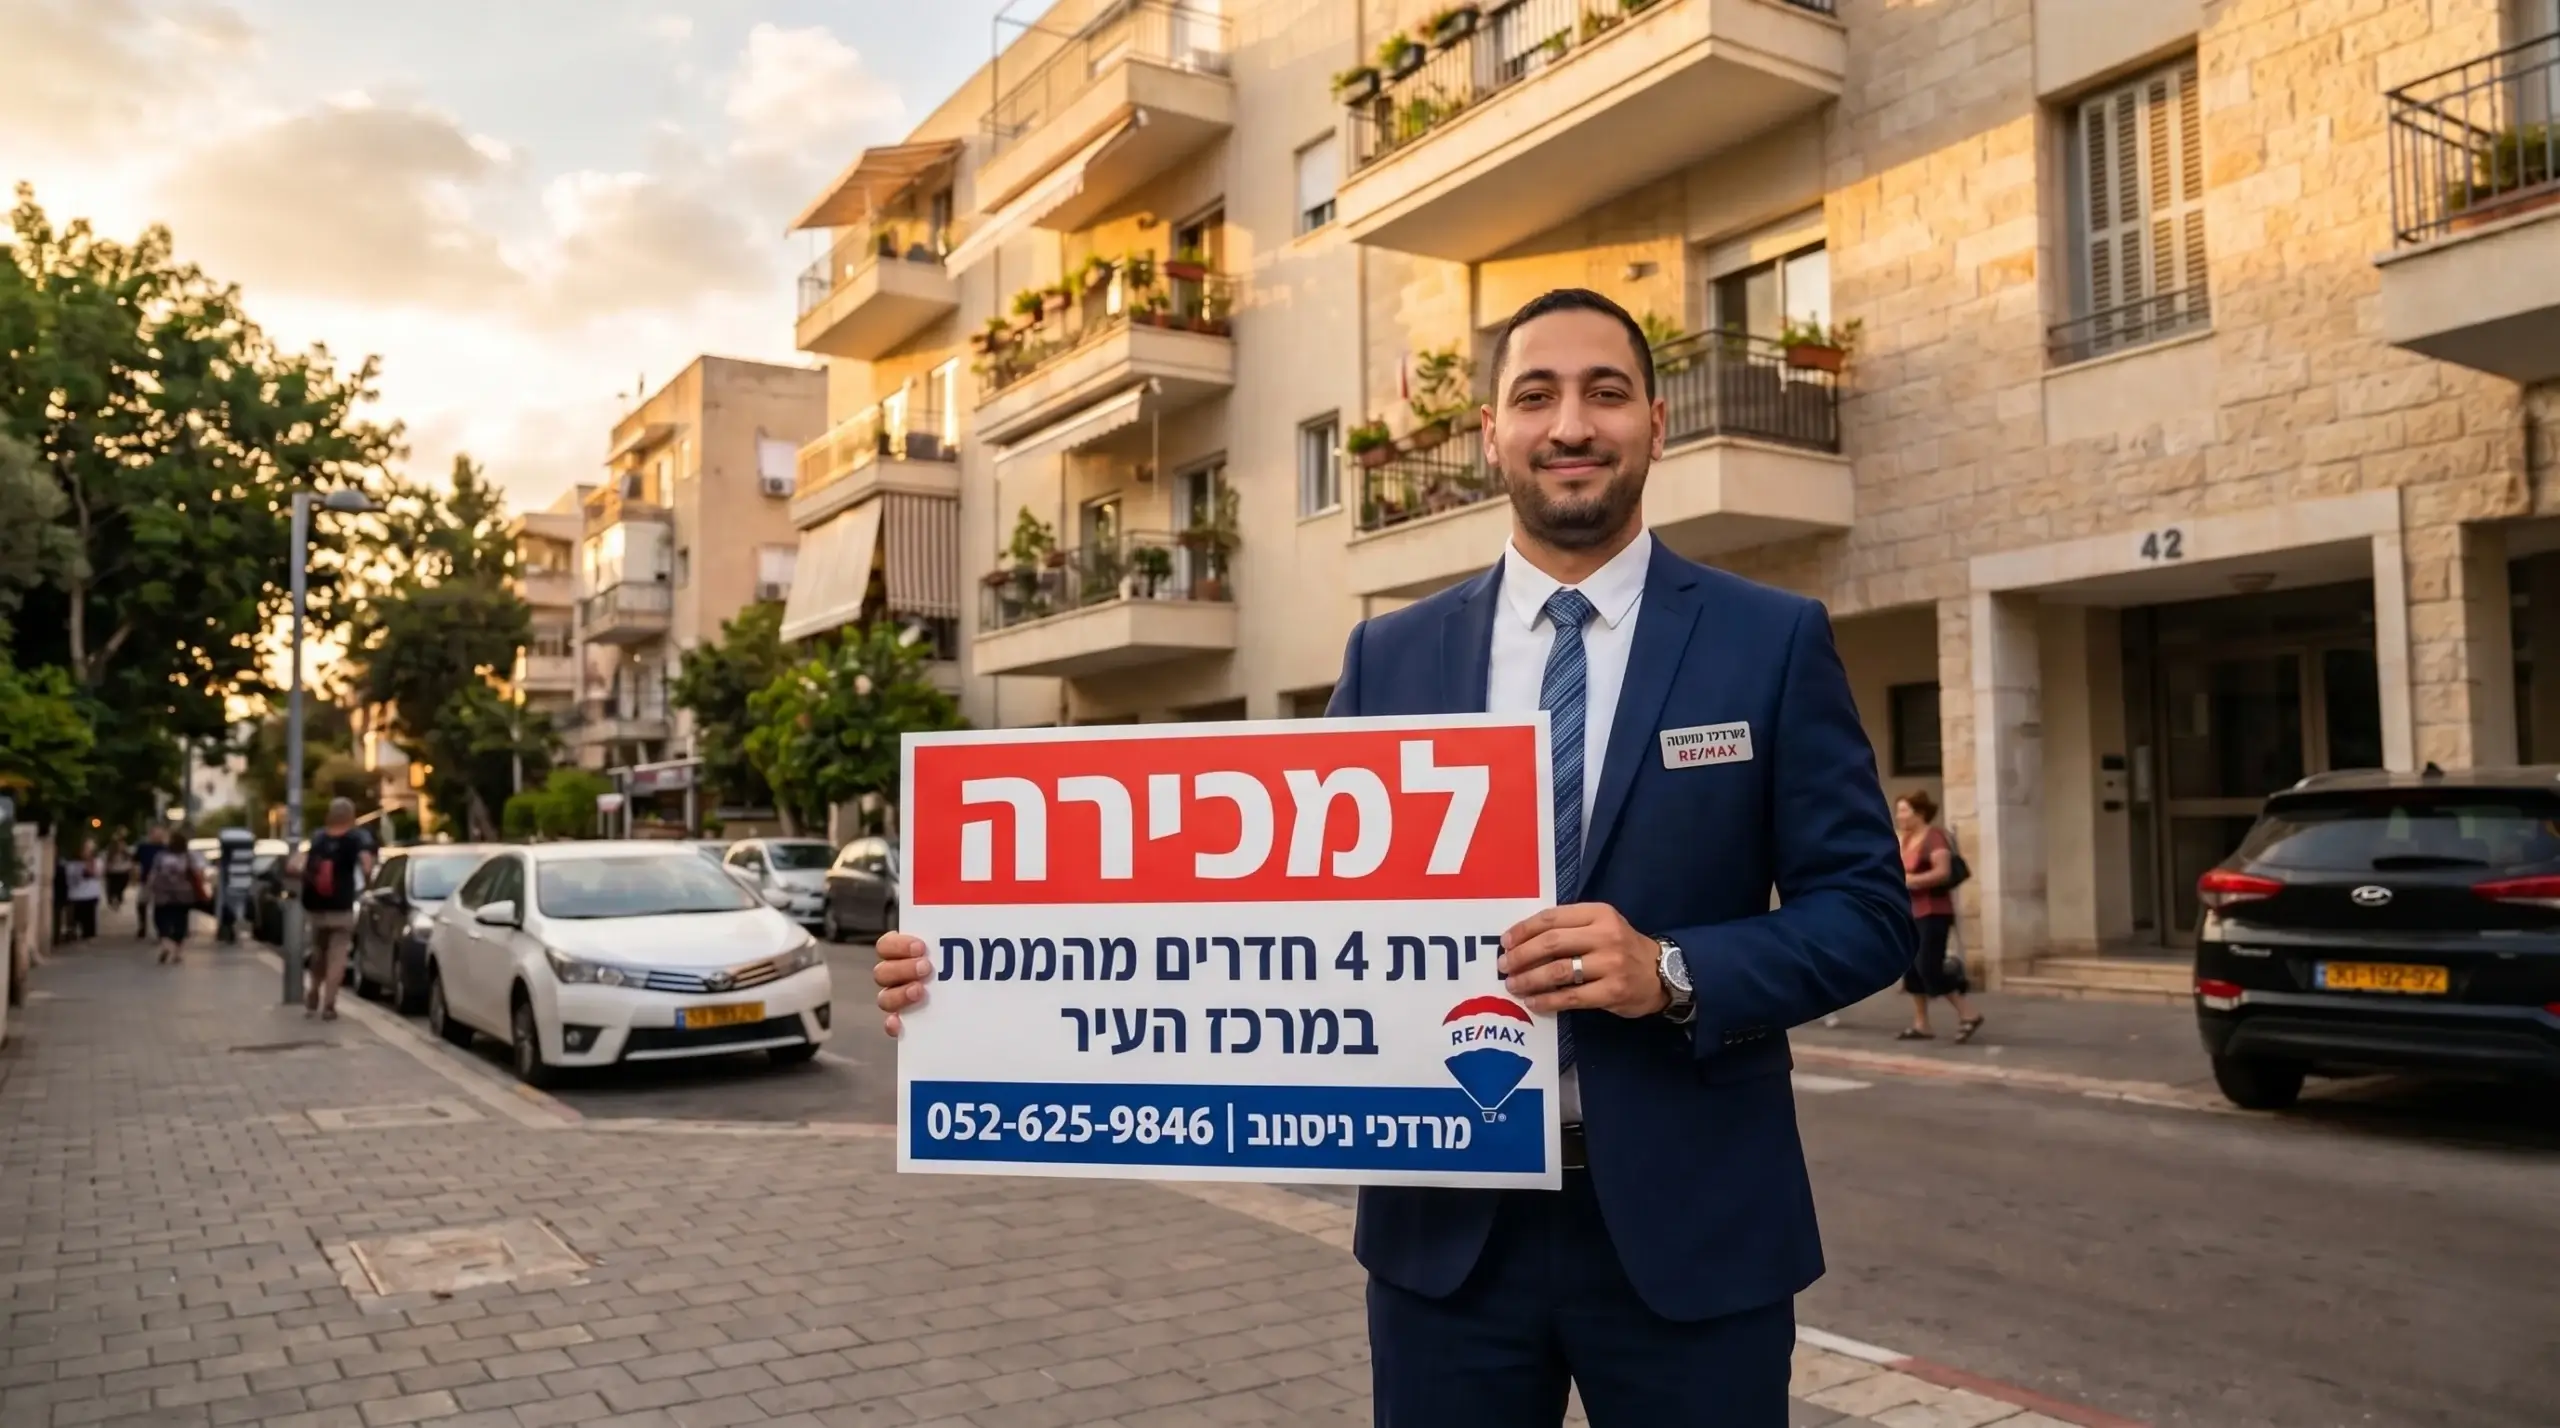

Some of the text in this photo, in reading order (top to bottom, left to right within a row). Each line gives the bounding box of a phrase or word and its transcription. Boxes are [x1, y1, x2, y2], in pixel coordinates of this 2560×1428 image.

[2141, 529, 2183, 560] 42
[1678, 744, 1738, 762] RE/MAX
[960, 739, 1490, 882] למכירה
[937, 937, 1137, 982] מהממת
[1156, 936, 1317, 982] חדרים
[1334, 930, 1369, 981] 4
[1061, 1007, 1379, 1056] במרכז העיר
[1451, 1024, 1525, 1047] RE/MAX
[927, 1102, 1472, 1149] מרדכי ניסנוב 052-625-9846
